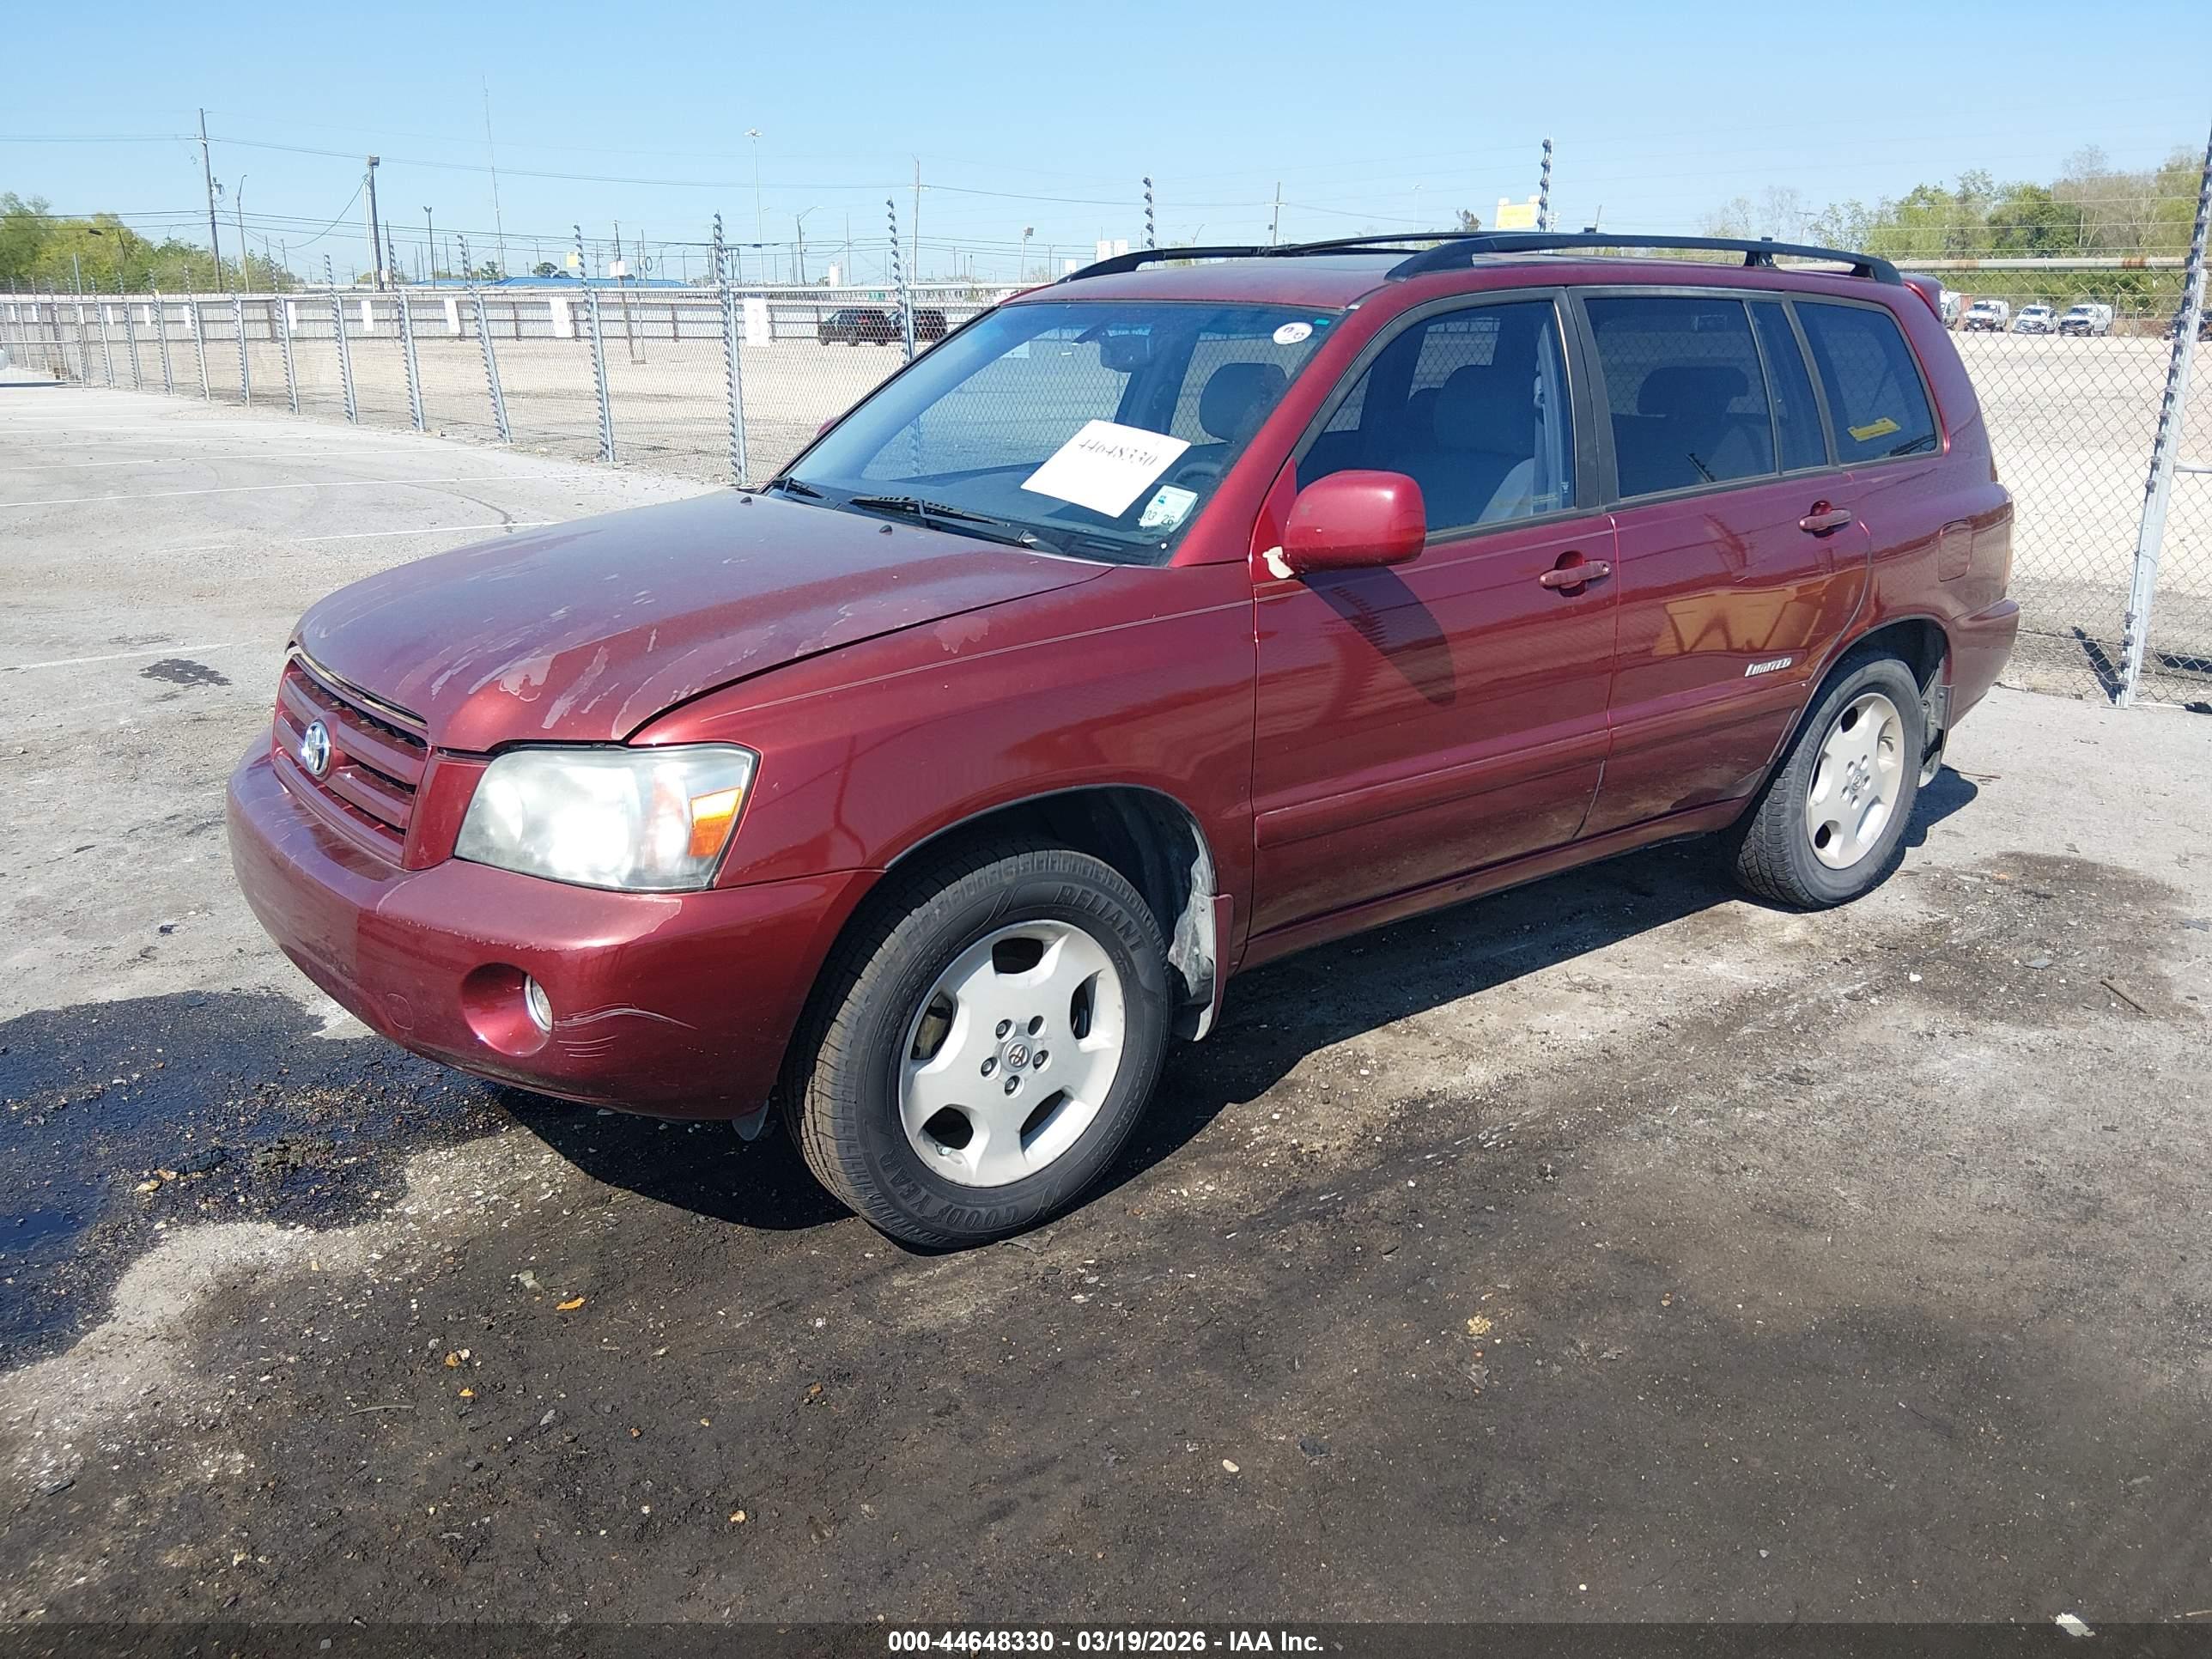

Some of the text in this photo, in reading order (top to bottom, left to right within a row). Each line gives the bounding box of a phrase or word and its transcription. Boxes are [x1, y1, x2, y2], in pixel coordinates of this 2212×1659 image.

[1079, 439, 1158, 466] 44648330
[1160, 514, 1176, 526] 26
[1053, 885, 1147, 955] RELIANT
